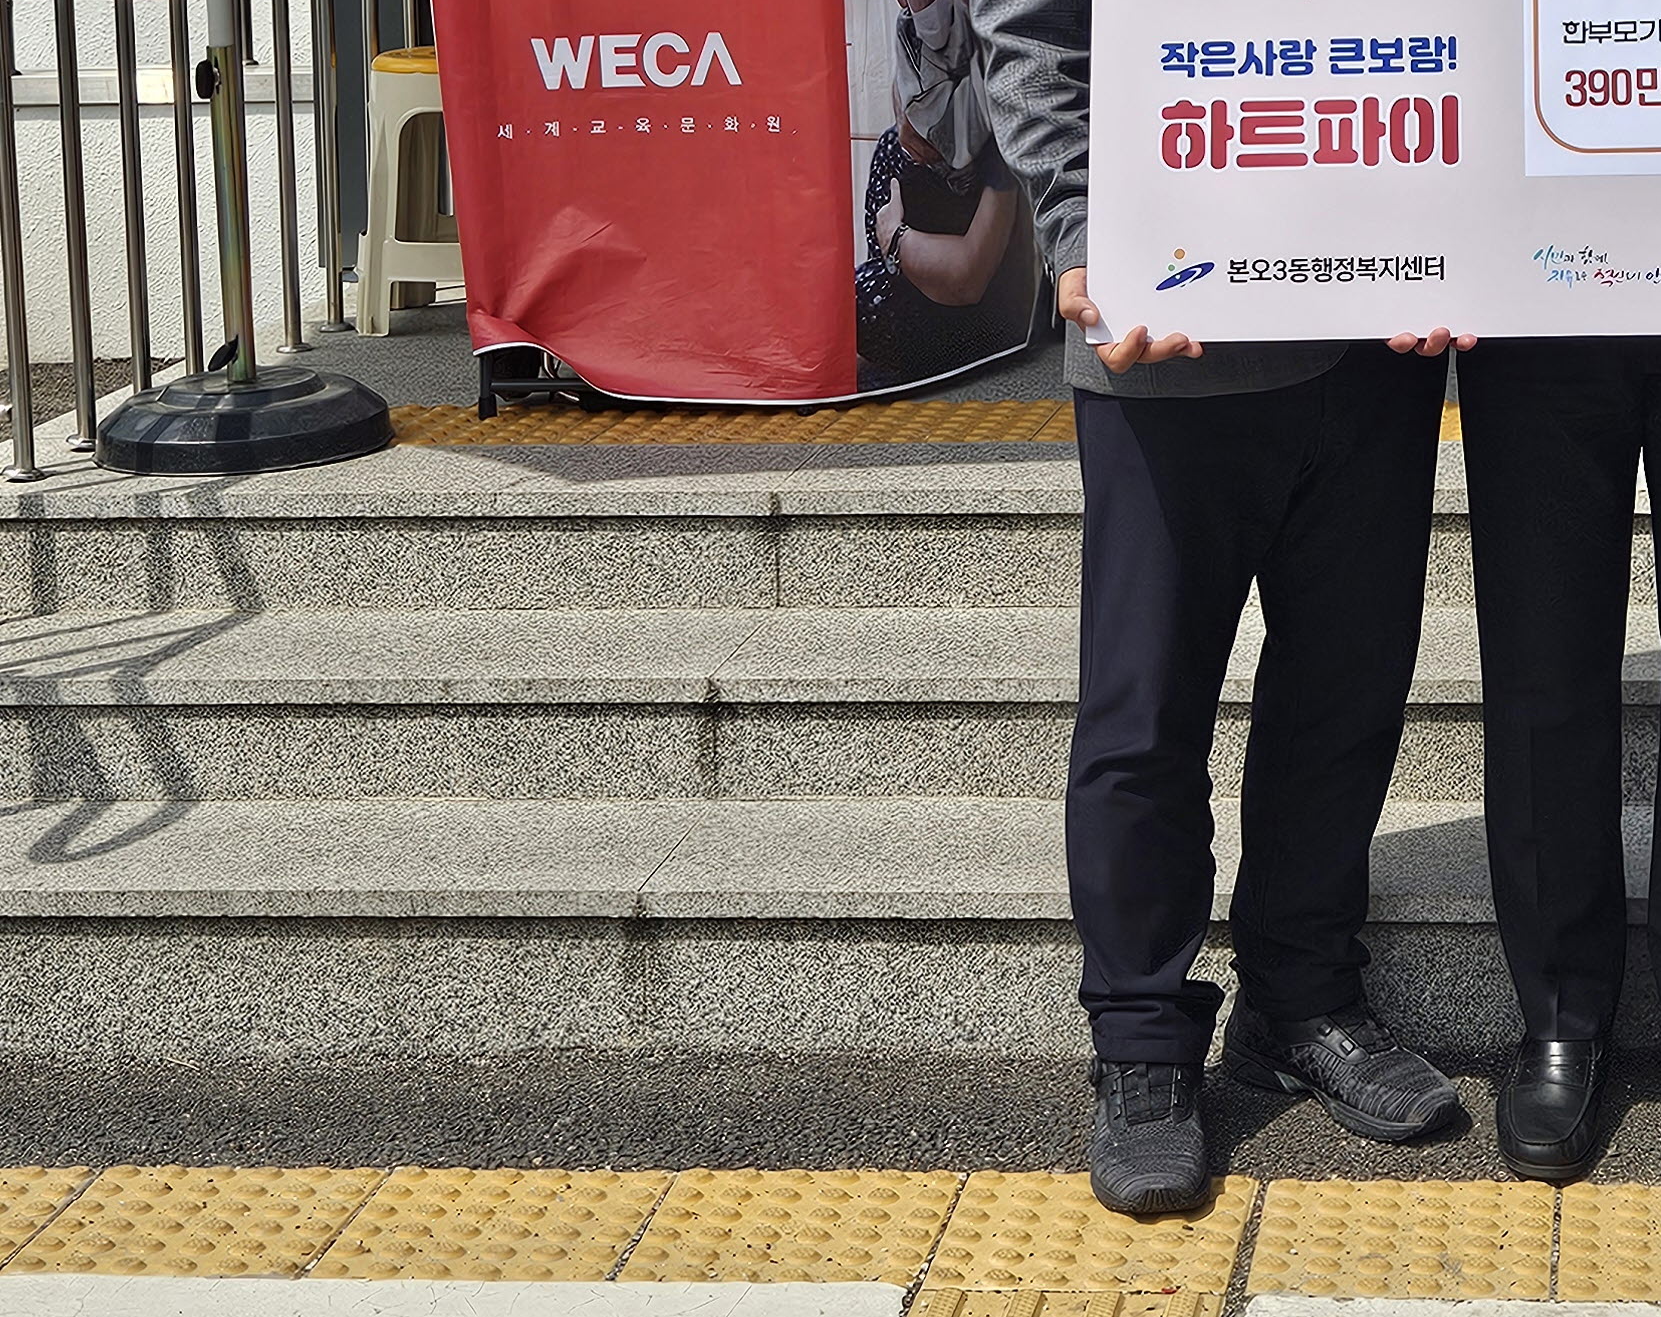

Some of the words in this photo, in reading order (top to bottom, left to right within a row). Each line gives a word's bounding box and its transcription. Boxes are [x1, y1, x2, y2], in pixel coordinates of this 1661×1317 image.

[530, 30, 743, 91] WECA
[1159, 37, 1317, 78] 작은사랑
[1329, 34, 1458, 75] 큰보람!
[1160, 94, 1461, 170] 하트파이
[1226, 255, 1446, 284] 본오3동행정복지센터
